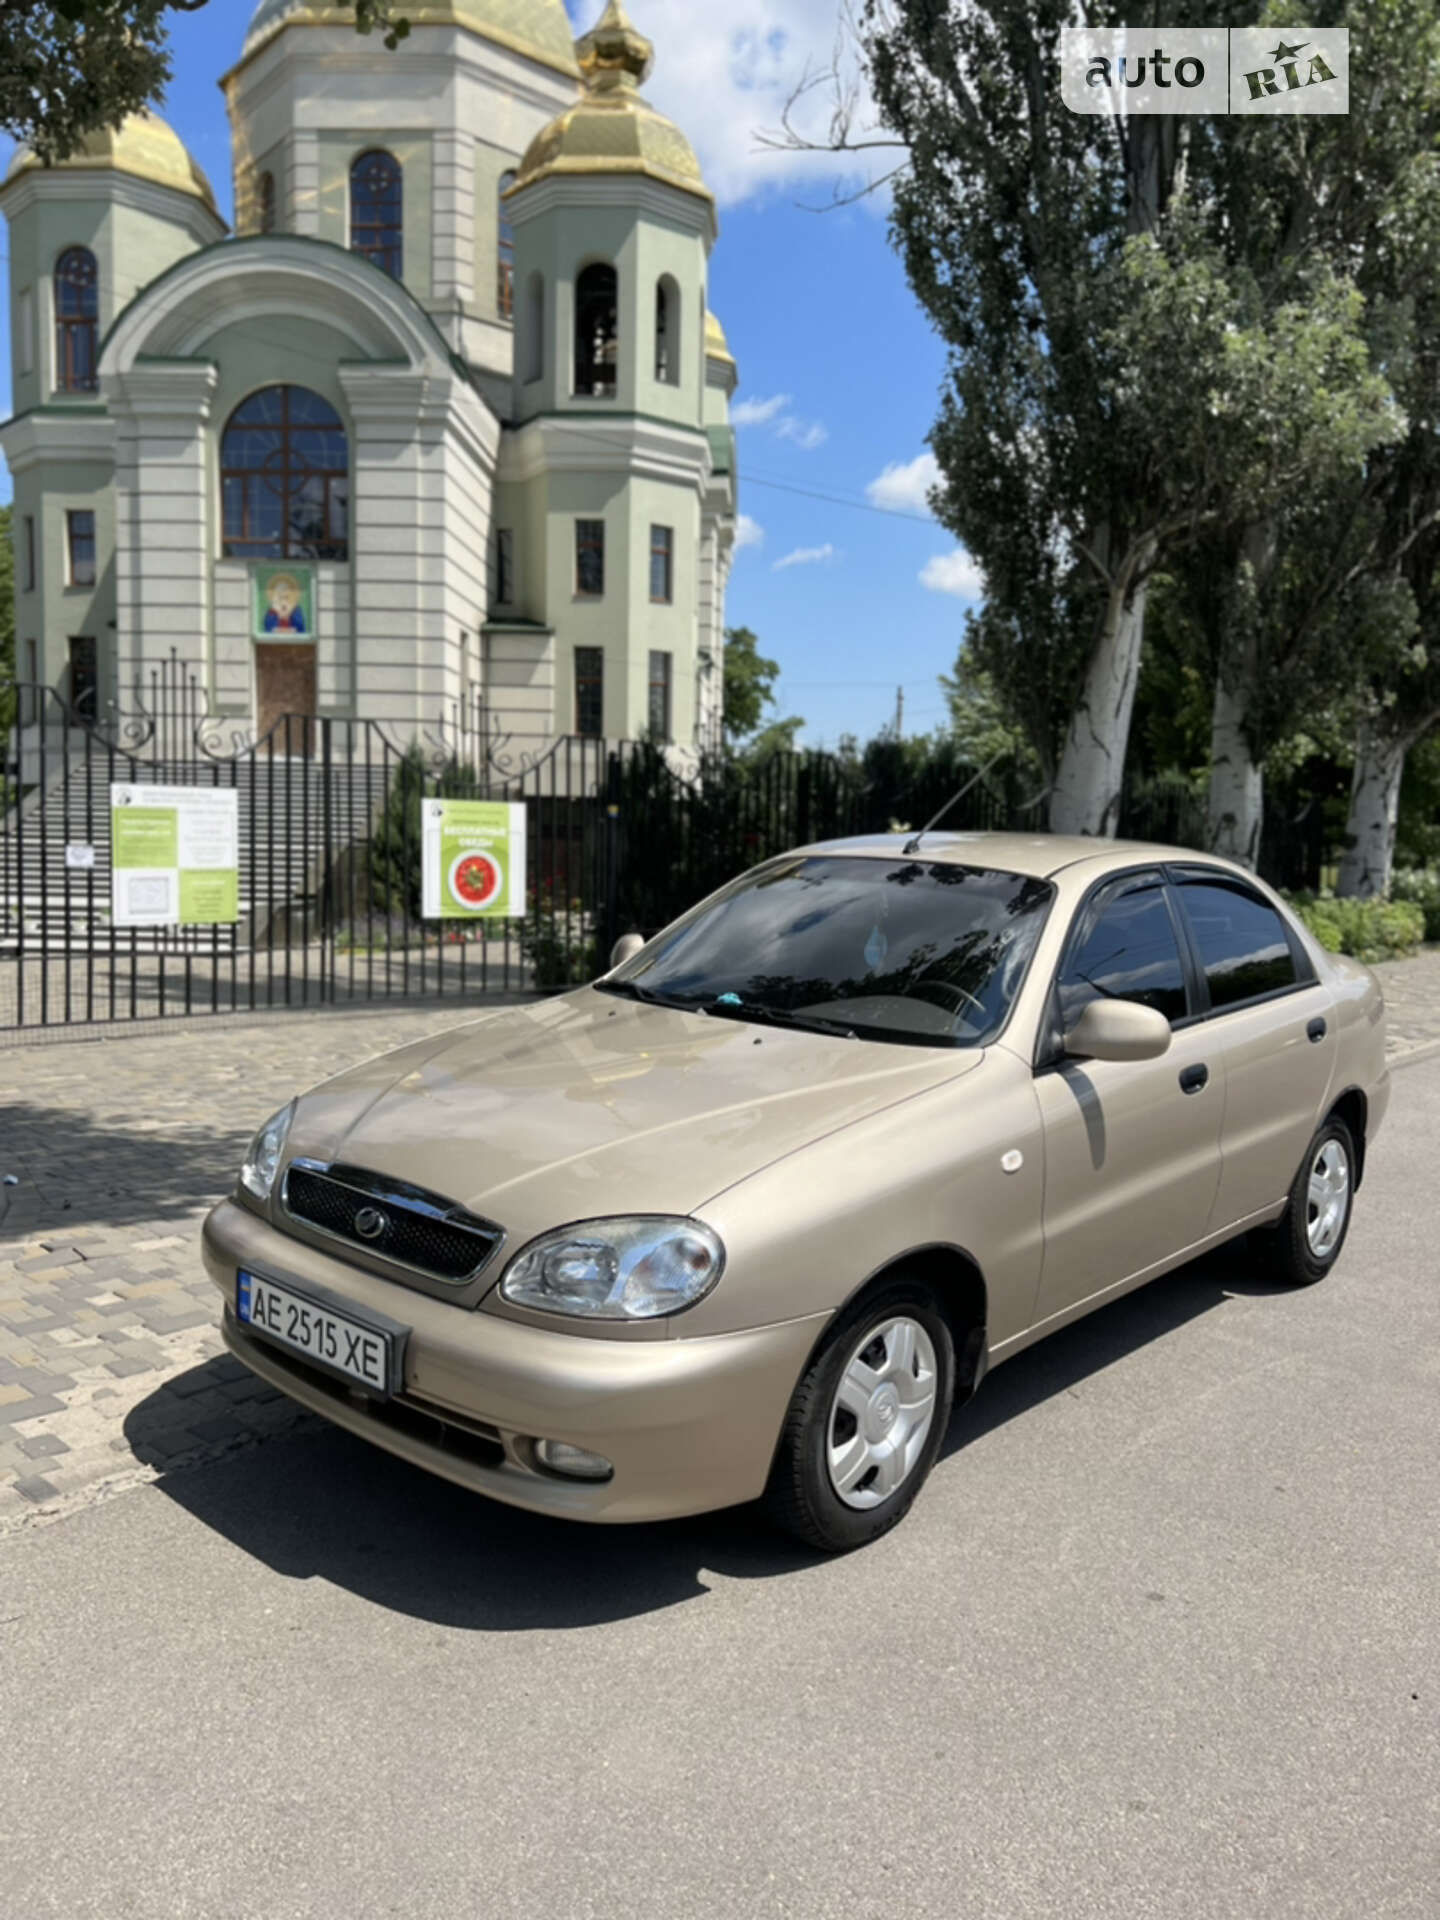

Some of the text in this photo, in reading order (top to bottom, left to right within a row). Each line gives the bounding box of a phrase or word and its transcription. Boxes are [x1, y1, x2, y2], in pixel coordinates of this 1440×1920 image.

[252, 1288, 379, 1382] AE 2515 XE
